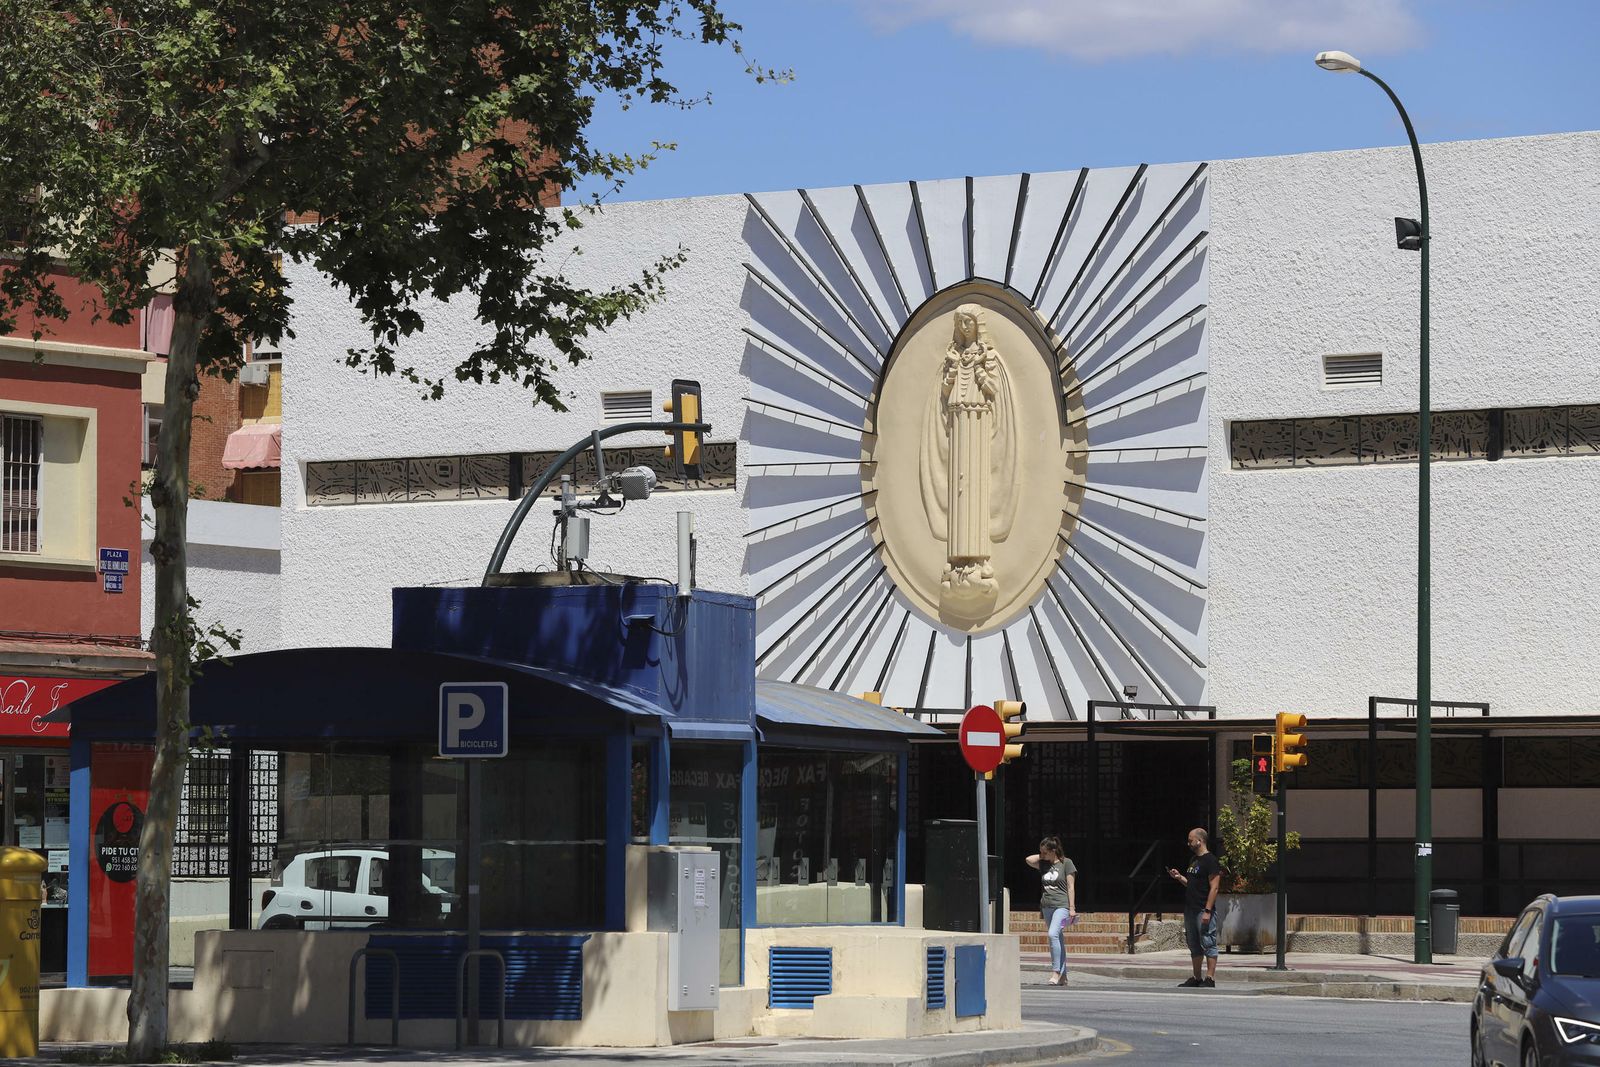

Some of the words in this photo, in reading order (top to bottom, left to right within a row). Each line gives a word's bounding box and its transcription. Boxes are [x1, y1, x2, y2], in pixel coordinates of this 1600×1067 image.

[447, 693, 485, 748] P
[460, 740, 498, 748] BICICLETAS
[101, 847, 117, 856] PIDE
[118, 847, 128, 856] TU
